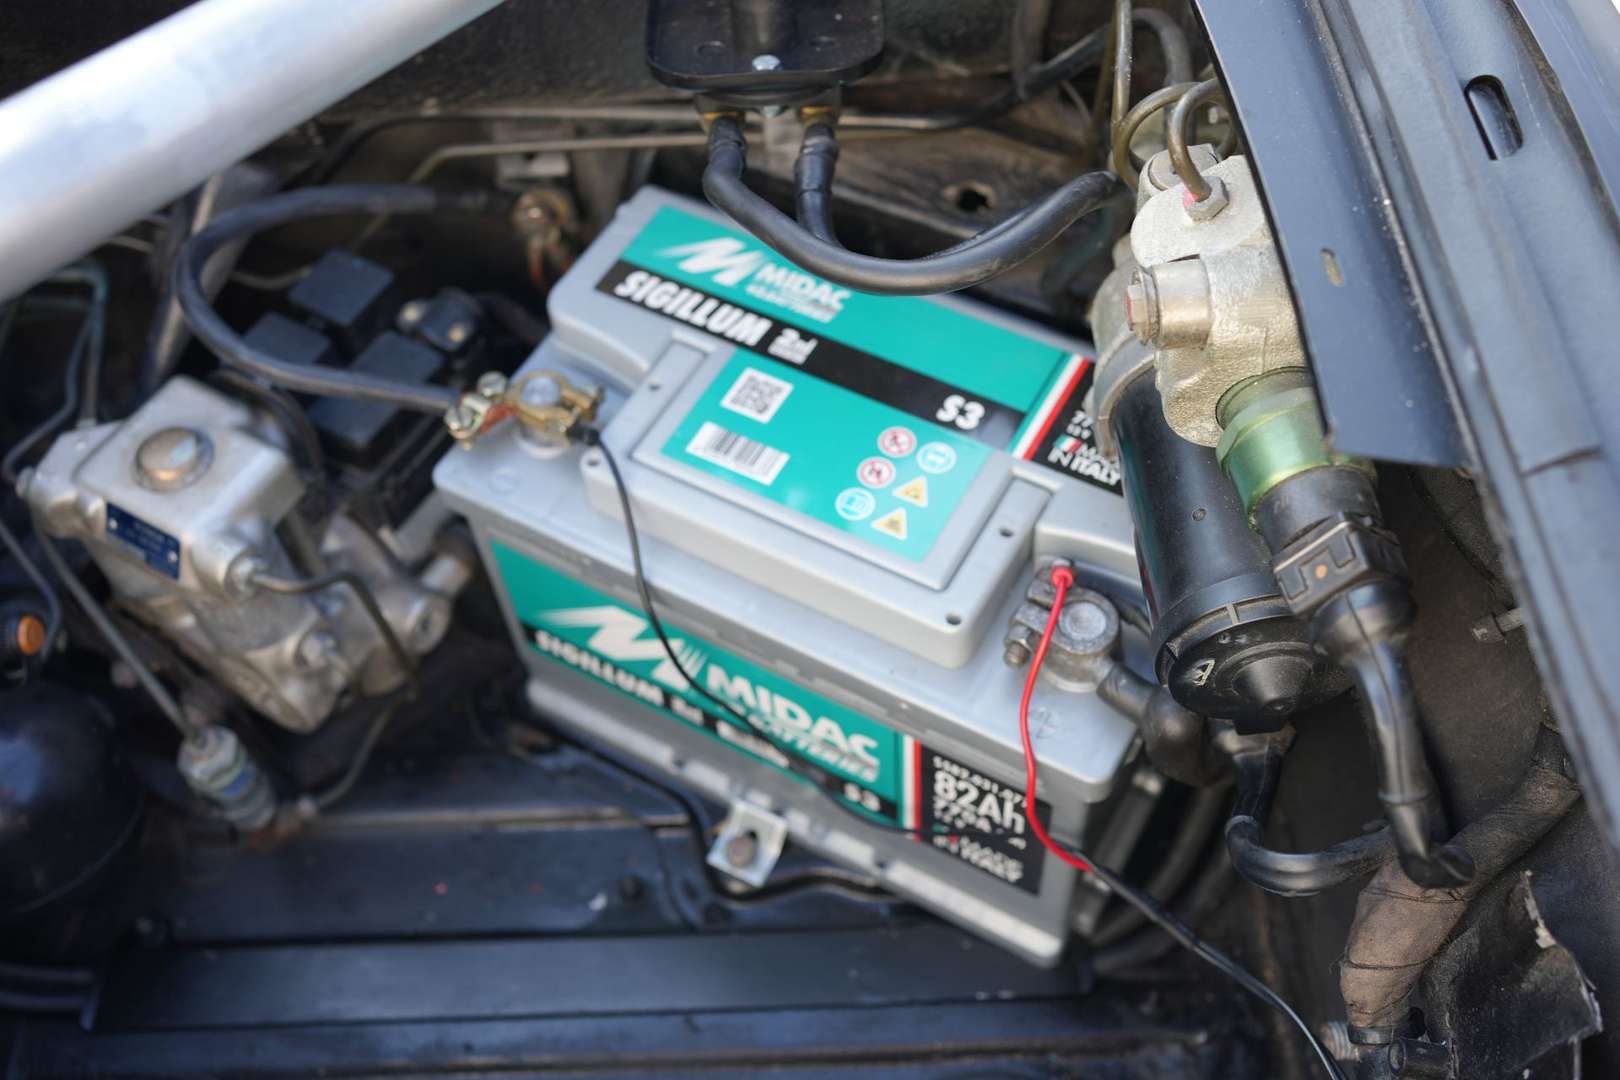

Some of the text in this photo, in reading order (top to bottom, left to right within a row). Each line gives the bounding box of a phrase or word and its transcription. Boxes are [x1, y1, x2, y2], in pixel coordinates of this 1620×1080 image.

[614, 270, 772, 347] SIGILLUM
[754, 262, 852, 312] MIDAC
[936, 394, 985, 430] S3
[706, 663, 880, 769] MIDAC
[933, 770, 1026, 834] 82Ah
